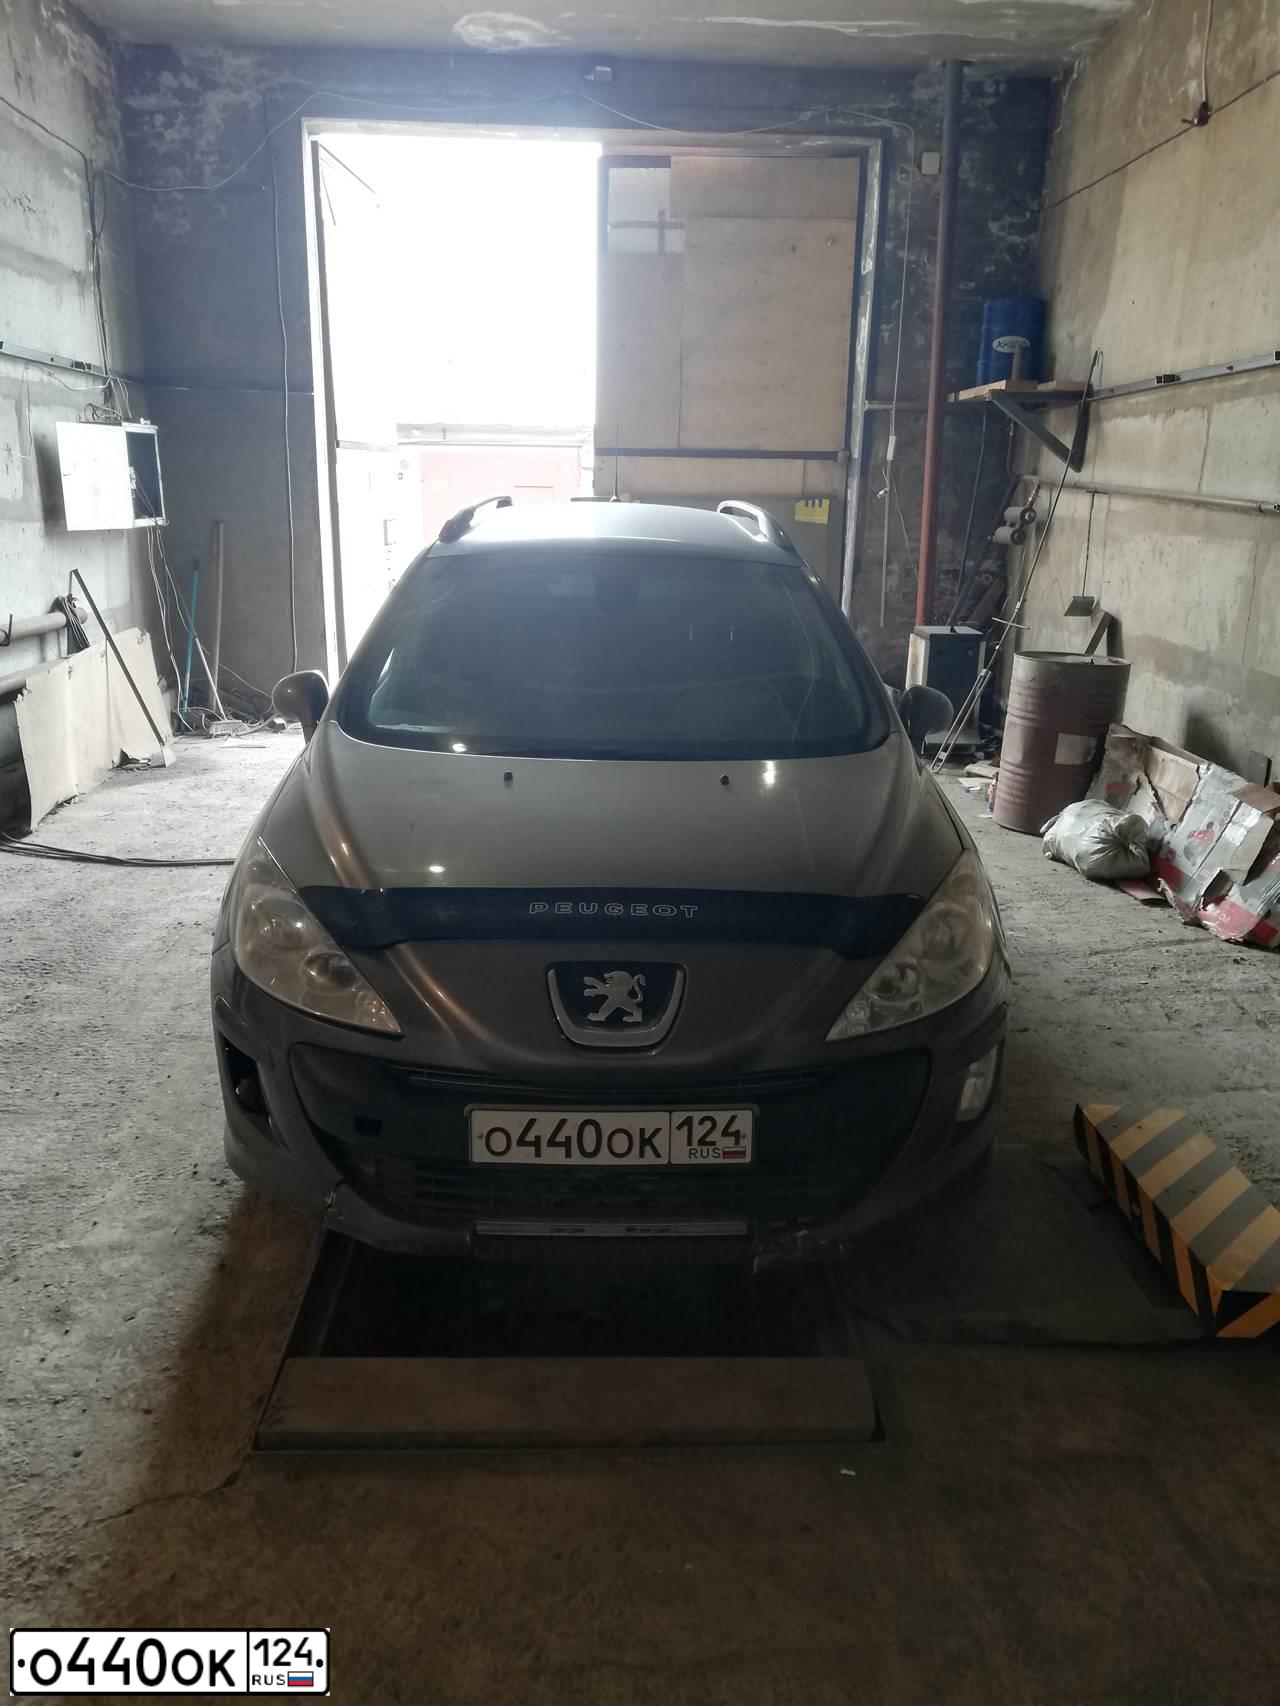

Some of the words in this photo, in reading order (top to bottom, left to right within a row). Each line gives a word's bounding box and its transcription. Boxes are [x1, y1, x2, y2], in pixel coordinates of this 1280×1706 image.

[529, 902, 699, 919] PEUGEOT
[676, 1115, 742, 1147] 124
[688, 1147, 721, 1159] RUS
